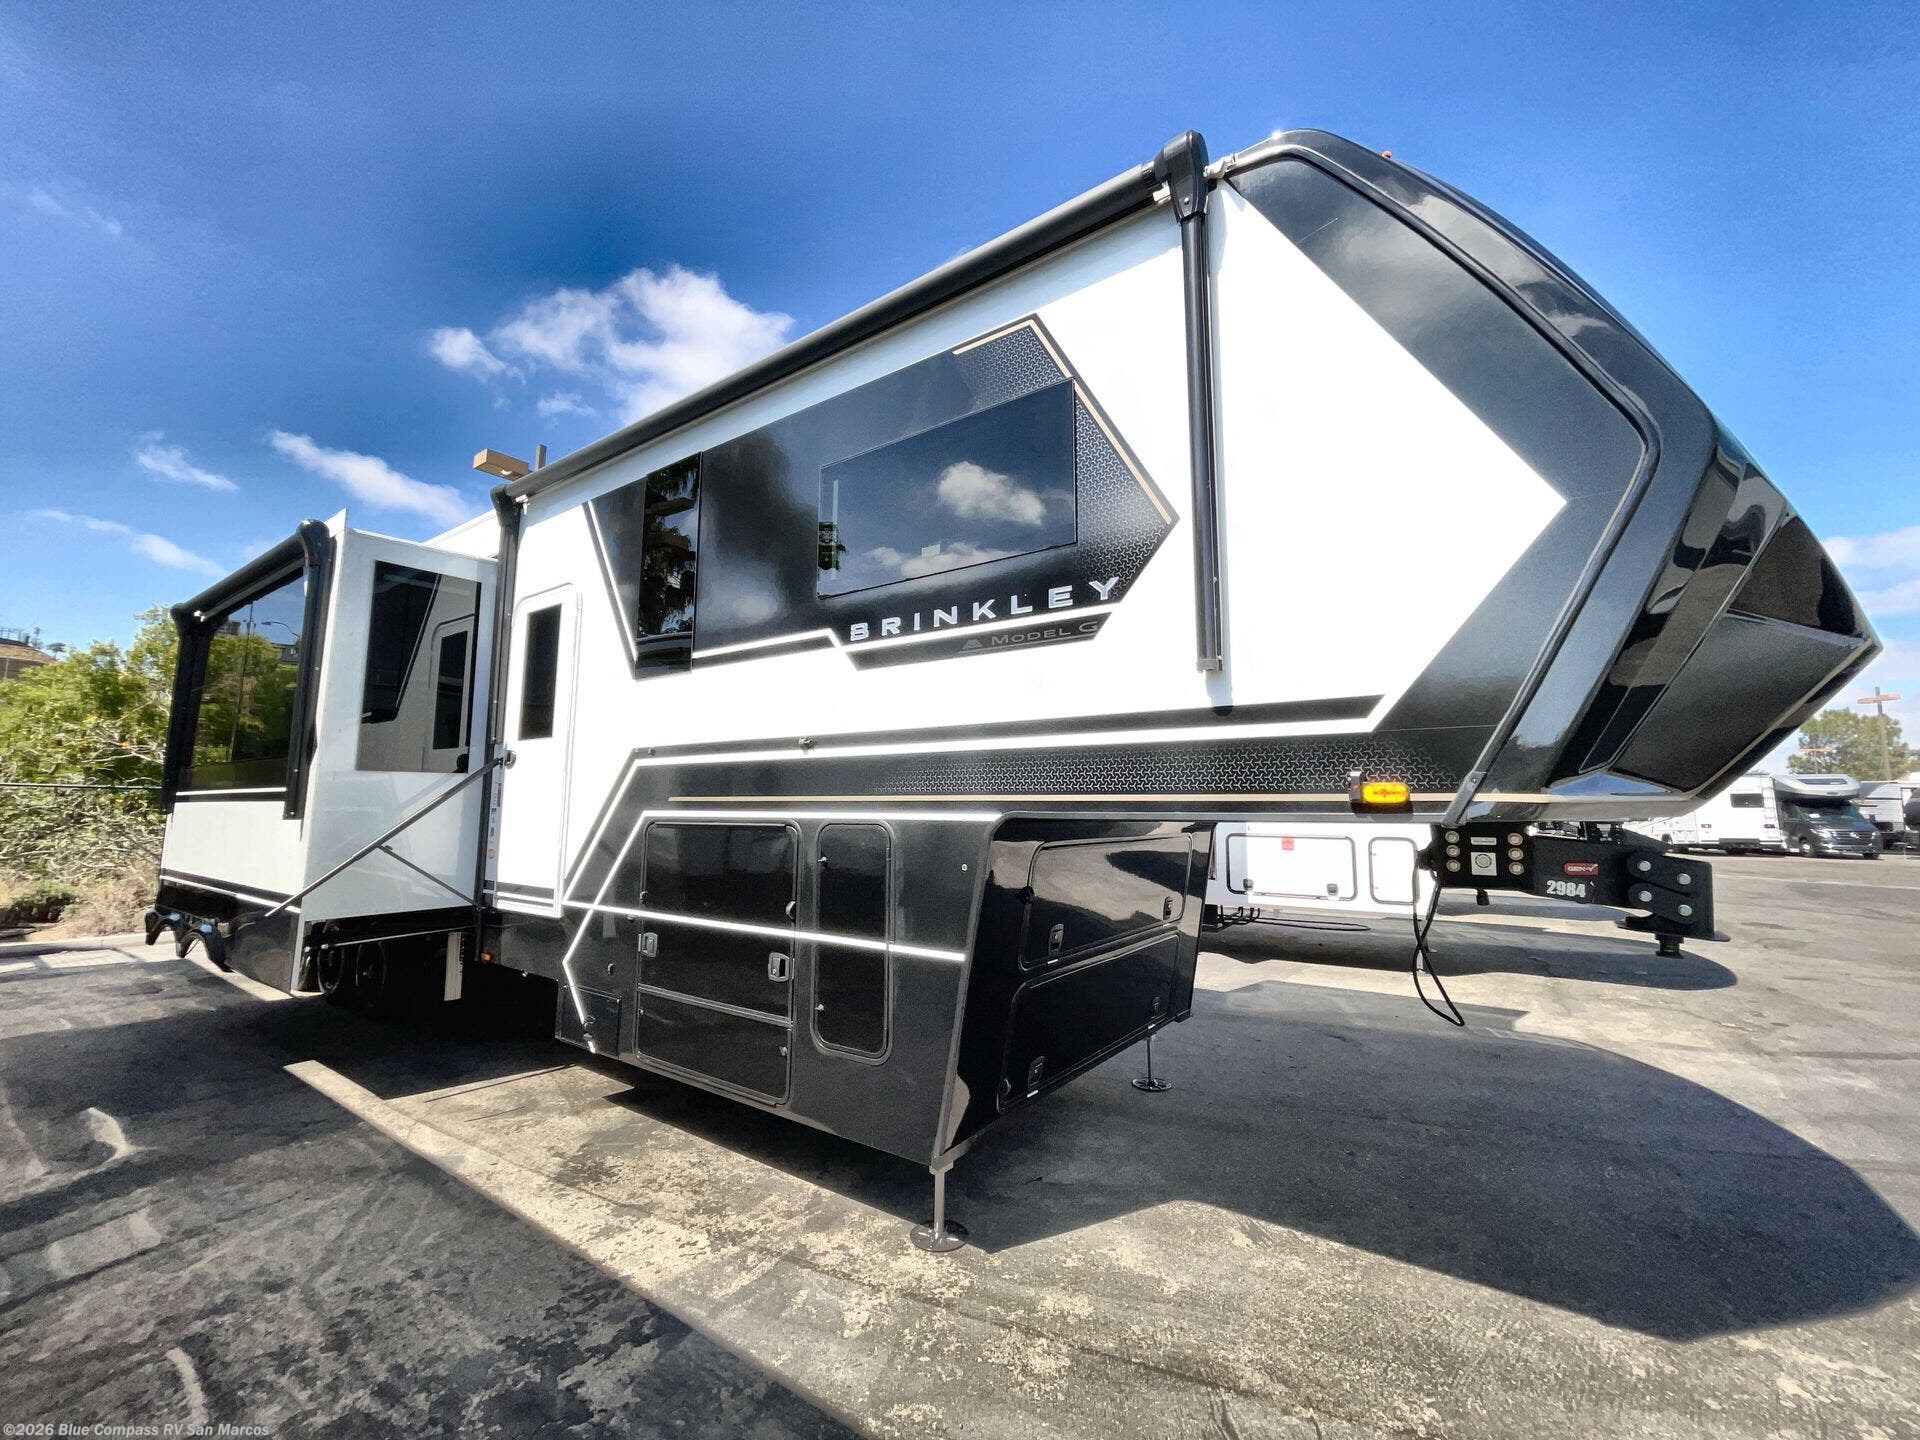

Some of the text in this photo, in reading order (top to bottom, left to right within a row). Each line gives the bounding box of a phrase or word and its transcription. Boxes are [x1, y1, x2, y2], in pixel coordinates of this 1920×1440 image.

[850, 576, 1119, 641] BRINKLEY
[991, 628, 1071, 646] MODEL
[1547, 880, 1586, 898] 2984
